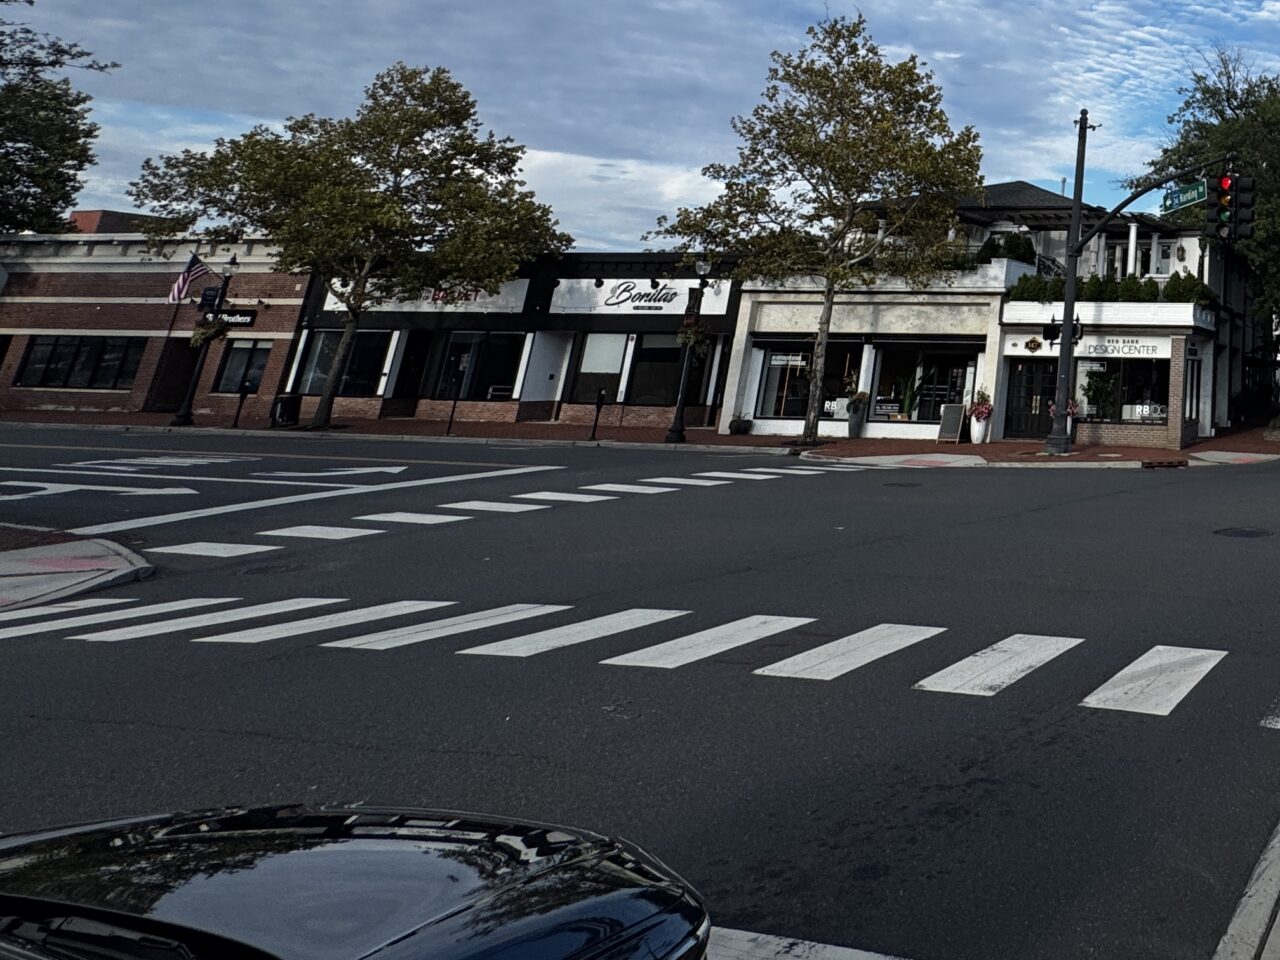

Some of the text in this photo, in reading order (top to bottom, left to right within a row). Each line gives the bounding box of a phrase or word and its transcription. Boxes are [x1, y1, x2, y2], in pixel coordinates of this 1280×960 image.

[432, 288, 481, 301] BAKET
[604, 280, 679, 306] Bonitas
[1088, 344, 1157, 355] DESIGN CENTER
[824, 400, 837, 411] RB
